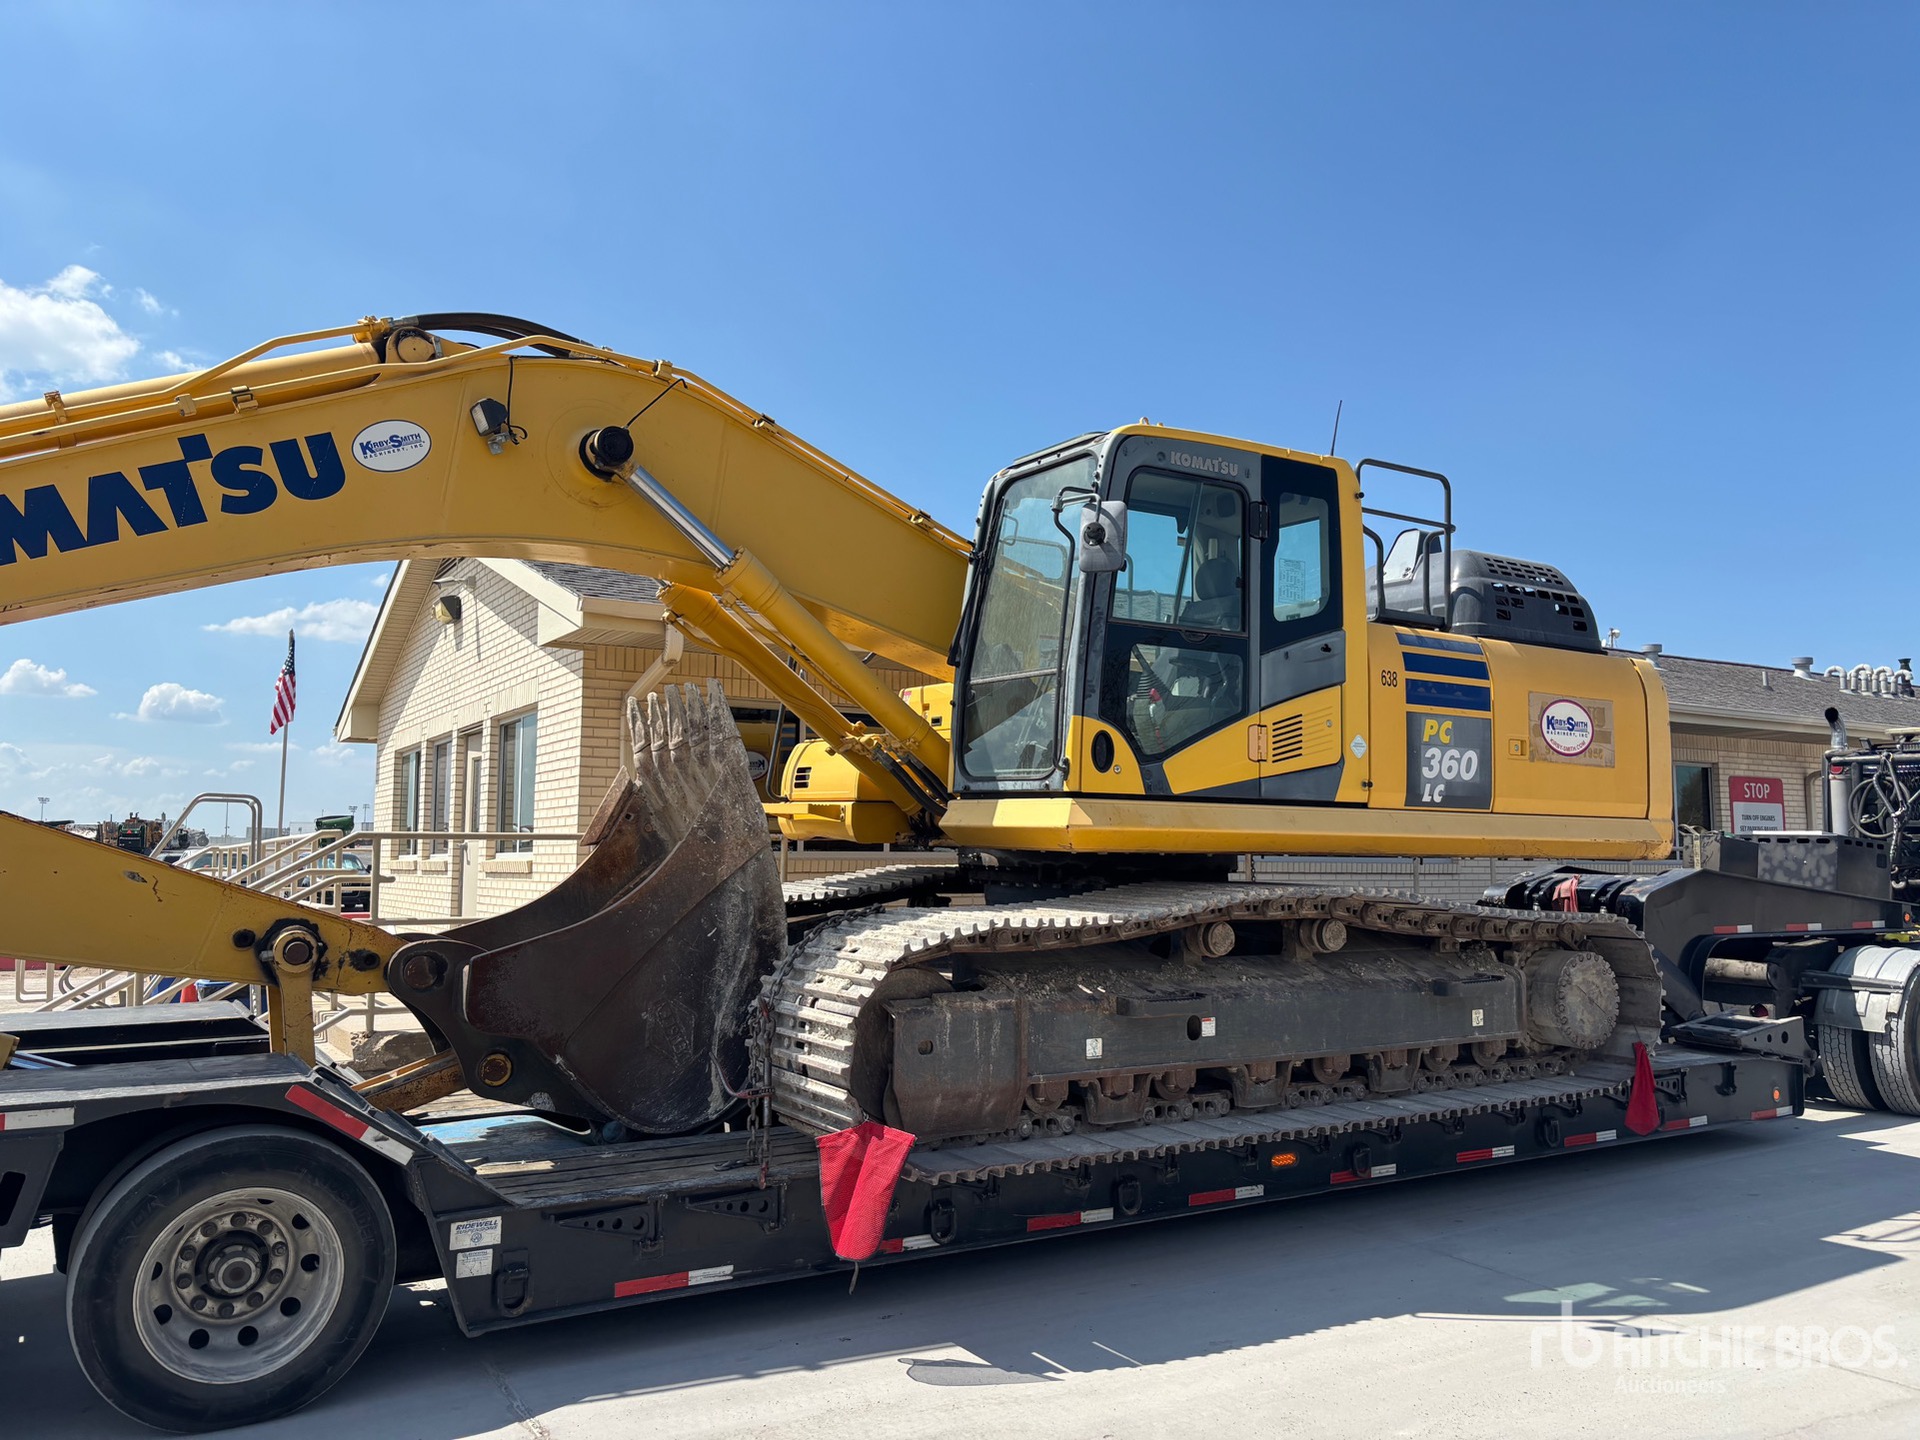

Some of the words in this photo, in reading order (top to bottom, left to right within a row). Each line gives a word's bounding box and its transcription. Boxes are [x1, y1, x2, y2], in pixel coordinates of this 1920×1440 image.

[359, 433, 421, 456] KIRBY-SMITH
[1170, 451, 1239, 477] KOMATSU
[1381, 670, 1398, 688] 638
[1423, 719, 1453, 744] PC
[1421, 747, 1479, 781] 360
[1421, 783, 1446, 803] LC
[1743, 782, 1770, 799] STOP
[456, 1220, 498, 1231] RIDEWELL
